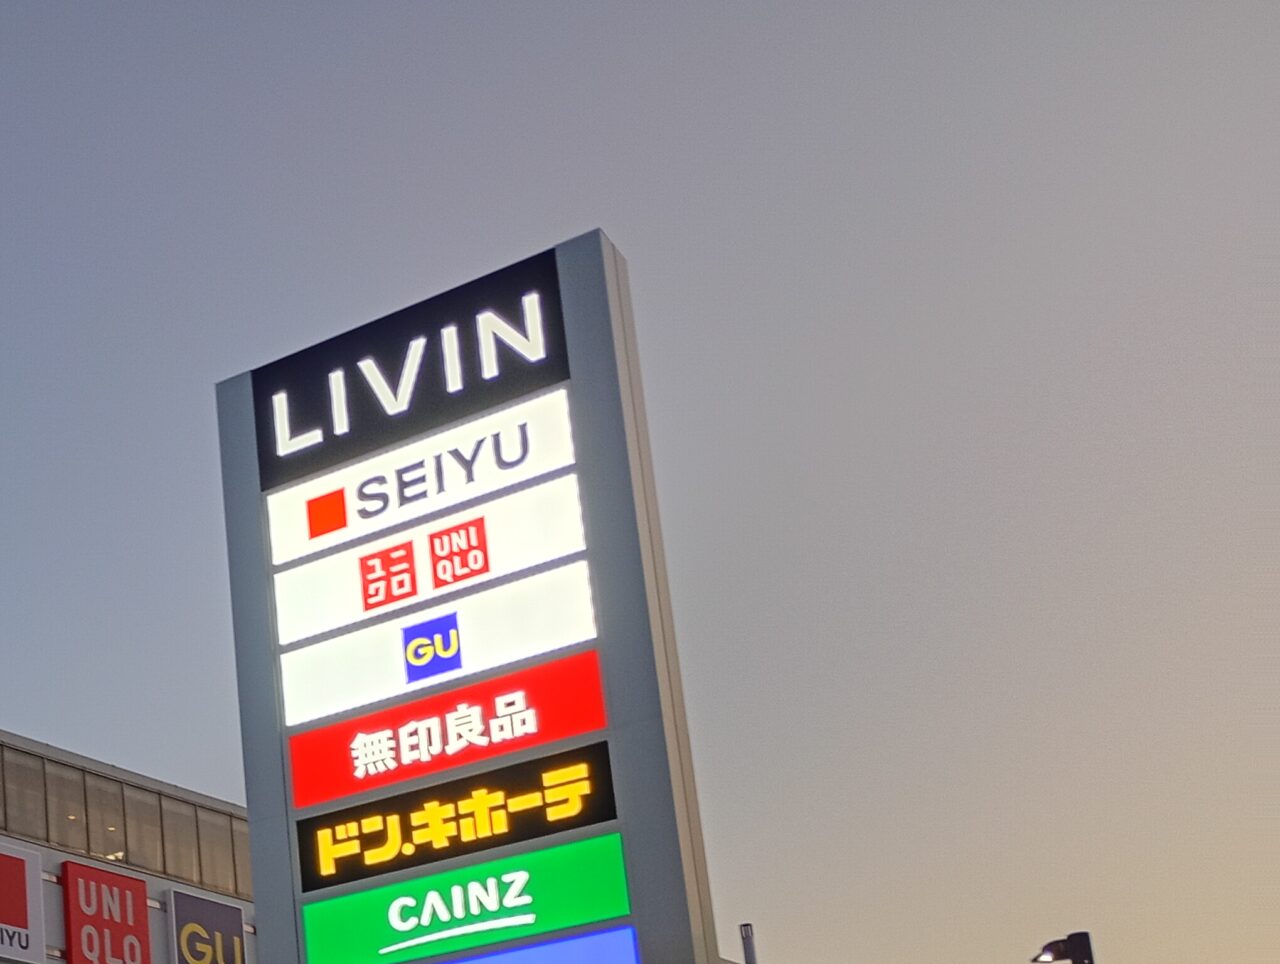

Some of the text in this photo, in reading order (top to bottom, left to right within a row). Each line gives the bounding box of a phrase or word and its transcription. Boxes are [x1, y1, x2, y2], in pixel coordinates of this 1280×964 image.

[272, 291, 546, 457] LIVIN
[356, 422, 530, 519] SEIYU
[434, 526, 480, 558] UNI
[436, 548, 485, 583] QLO
[405, 628, 460, 666] GU
[350, 691, 538, 779] 無印良品
[78, 878, 134, 926] UNI
[388, 870, 533, 932] CAINZ
